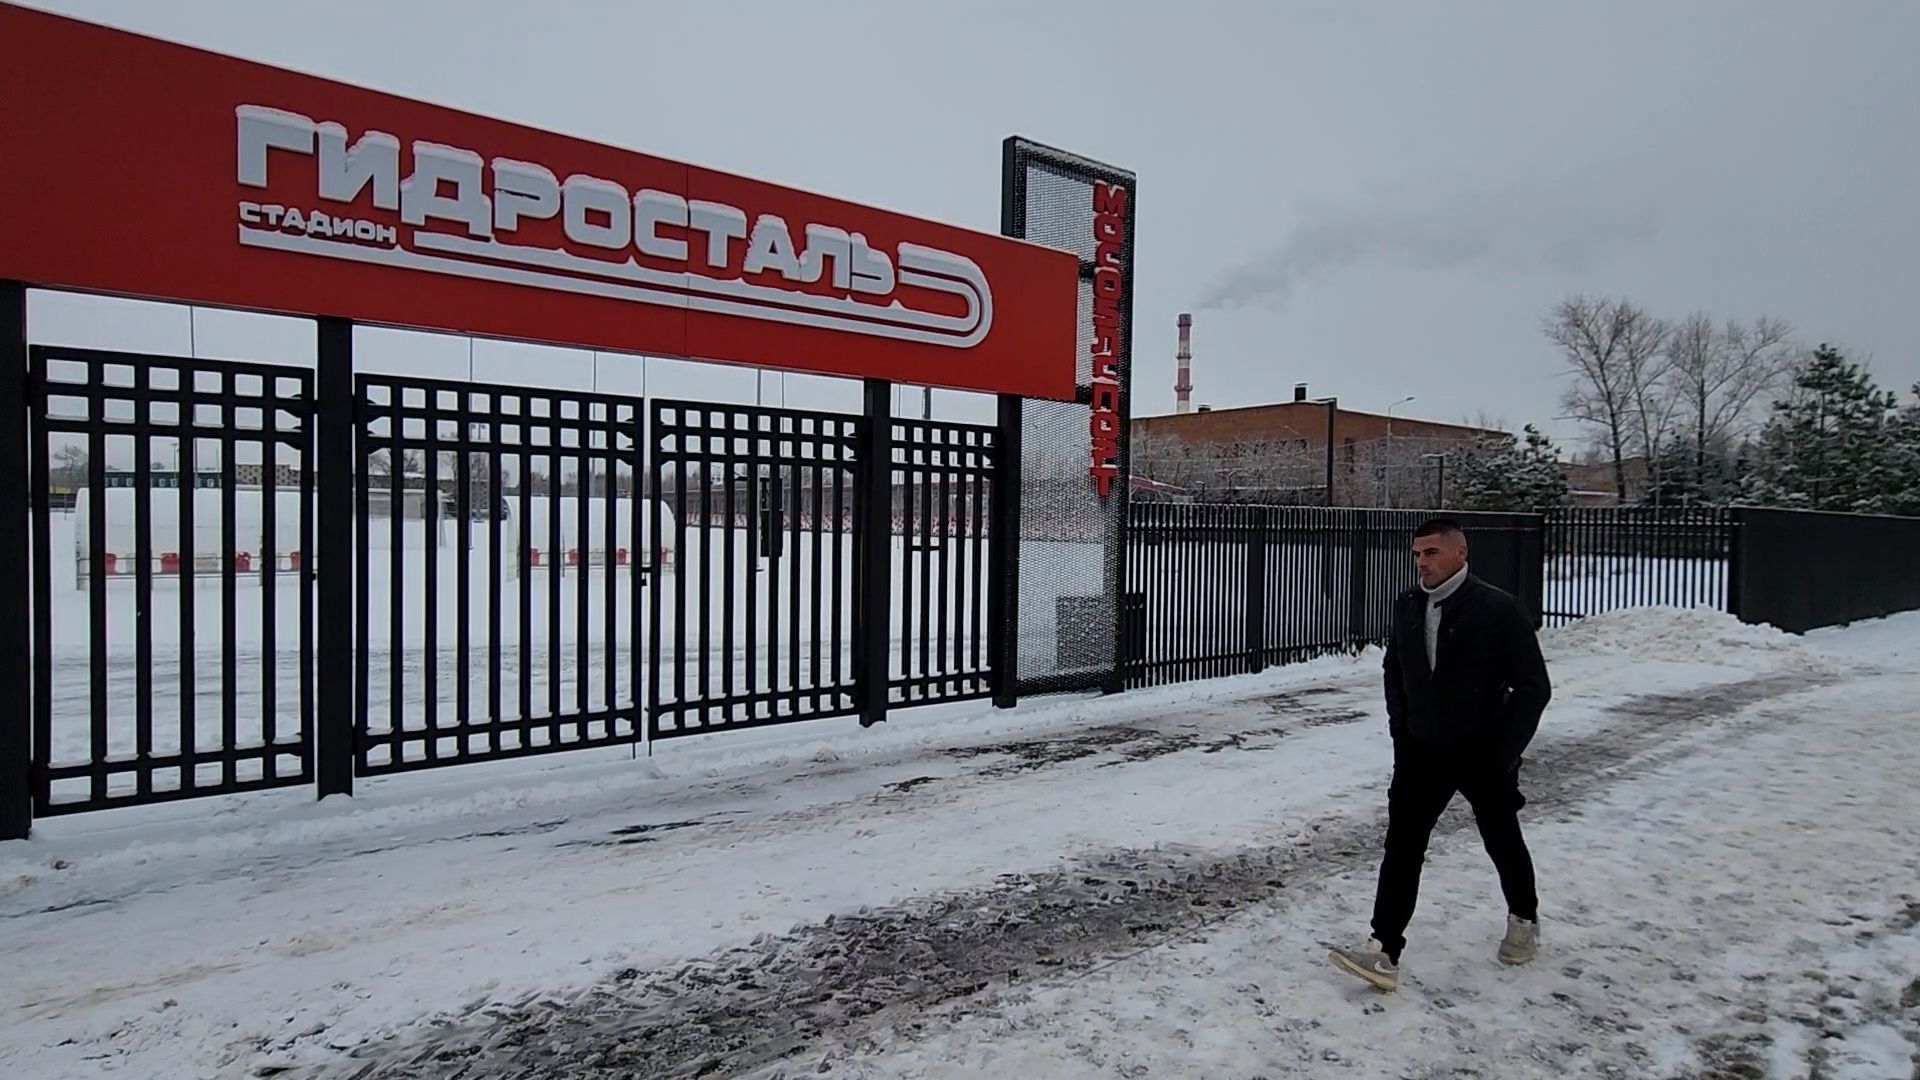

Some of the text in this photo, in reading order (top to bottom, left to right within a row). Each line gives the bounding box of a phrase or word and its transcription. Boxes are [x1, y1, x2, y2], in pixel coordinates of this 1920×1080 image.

[236, 105, 895, 295] ГИДРОСТАЛЬ
[239, 202, 397, 244] СТАДИОН
[1091, 180, 1126, 496] МОСОБЛСПОРТ
